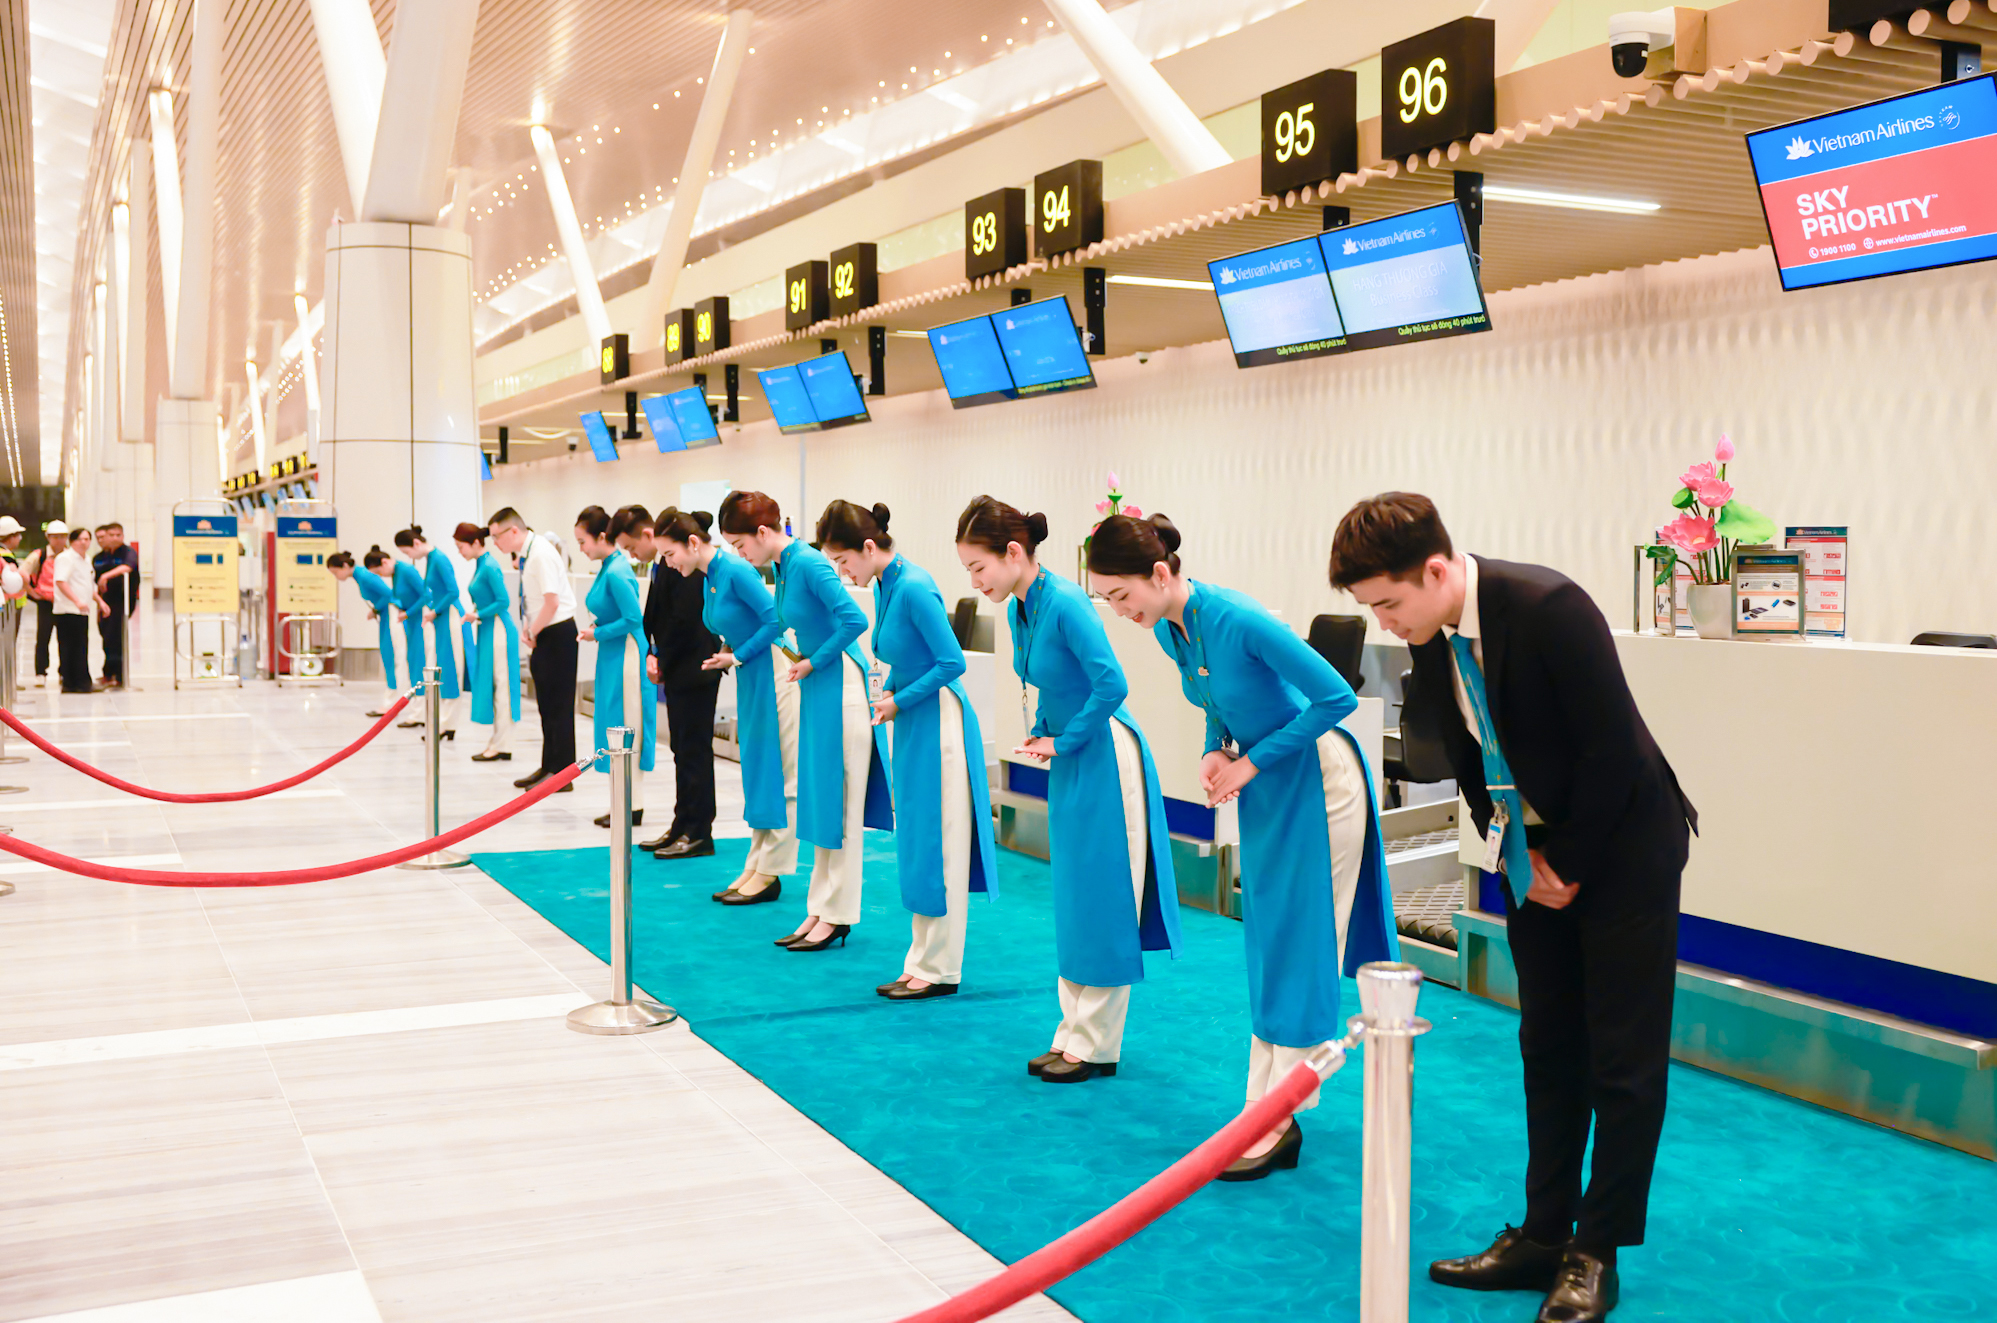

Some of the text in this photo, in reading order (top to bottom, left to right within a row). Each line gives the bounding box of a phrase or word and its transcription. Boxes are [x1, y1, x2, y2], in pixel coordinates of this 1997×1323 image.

[1399, 57, 1448, 124] 96
[1274, 102, 1316, 163] 95
[1812, 114, 1934, 154] Vietnam Airlines
[1042, 184, 1071, 233] 94
[1796, 185, 1849, 216] SKY
[972, 212, 997, 256] 93
[1357, 228, 1426, 252] Vietnam Airlines
[1820, 224, 1967, 256] 1900 1100 www.vietnamairlines.com
[834, 262, 854, 299] 92
[1234, 258, 1302, 281] Vietnam Airlines
[790, 278, 806, 314] 91
[1370, 284, 1438, 307] Business Class
[697, 311, 712, 343] 90
[1453, 318, 1460, 327] 40
